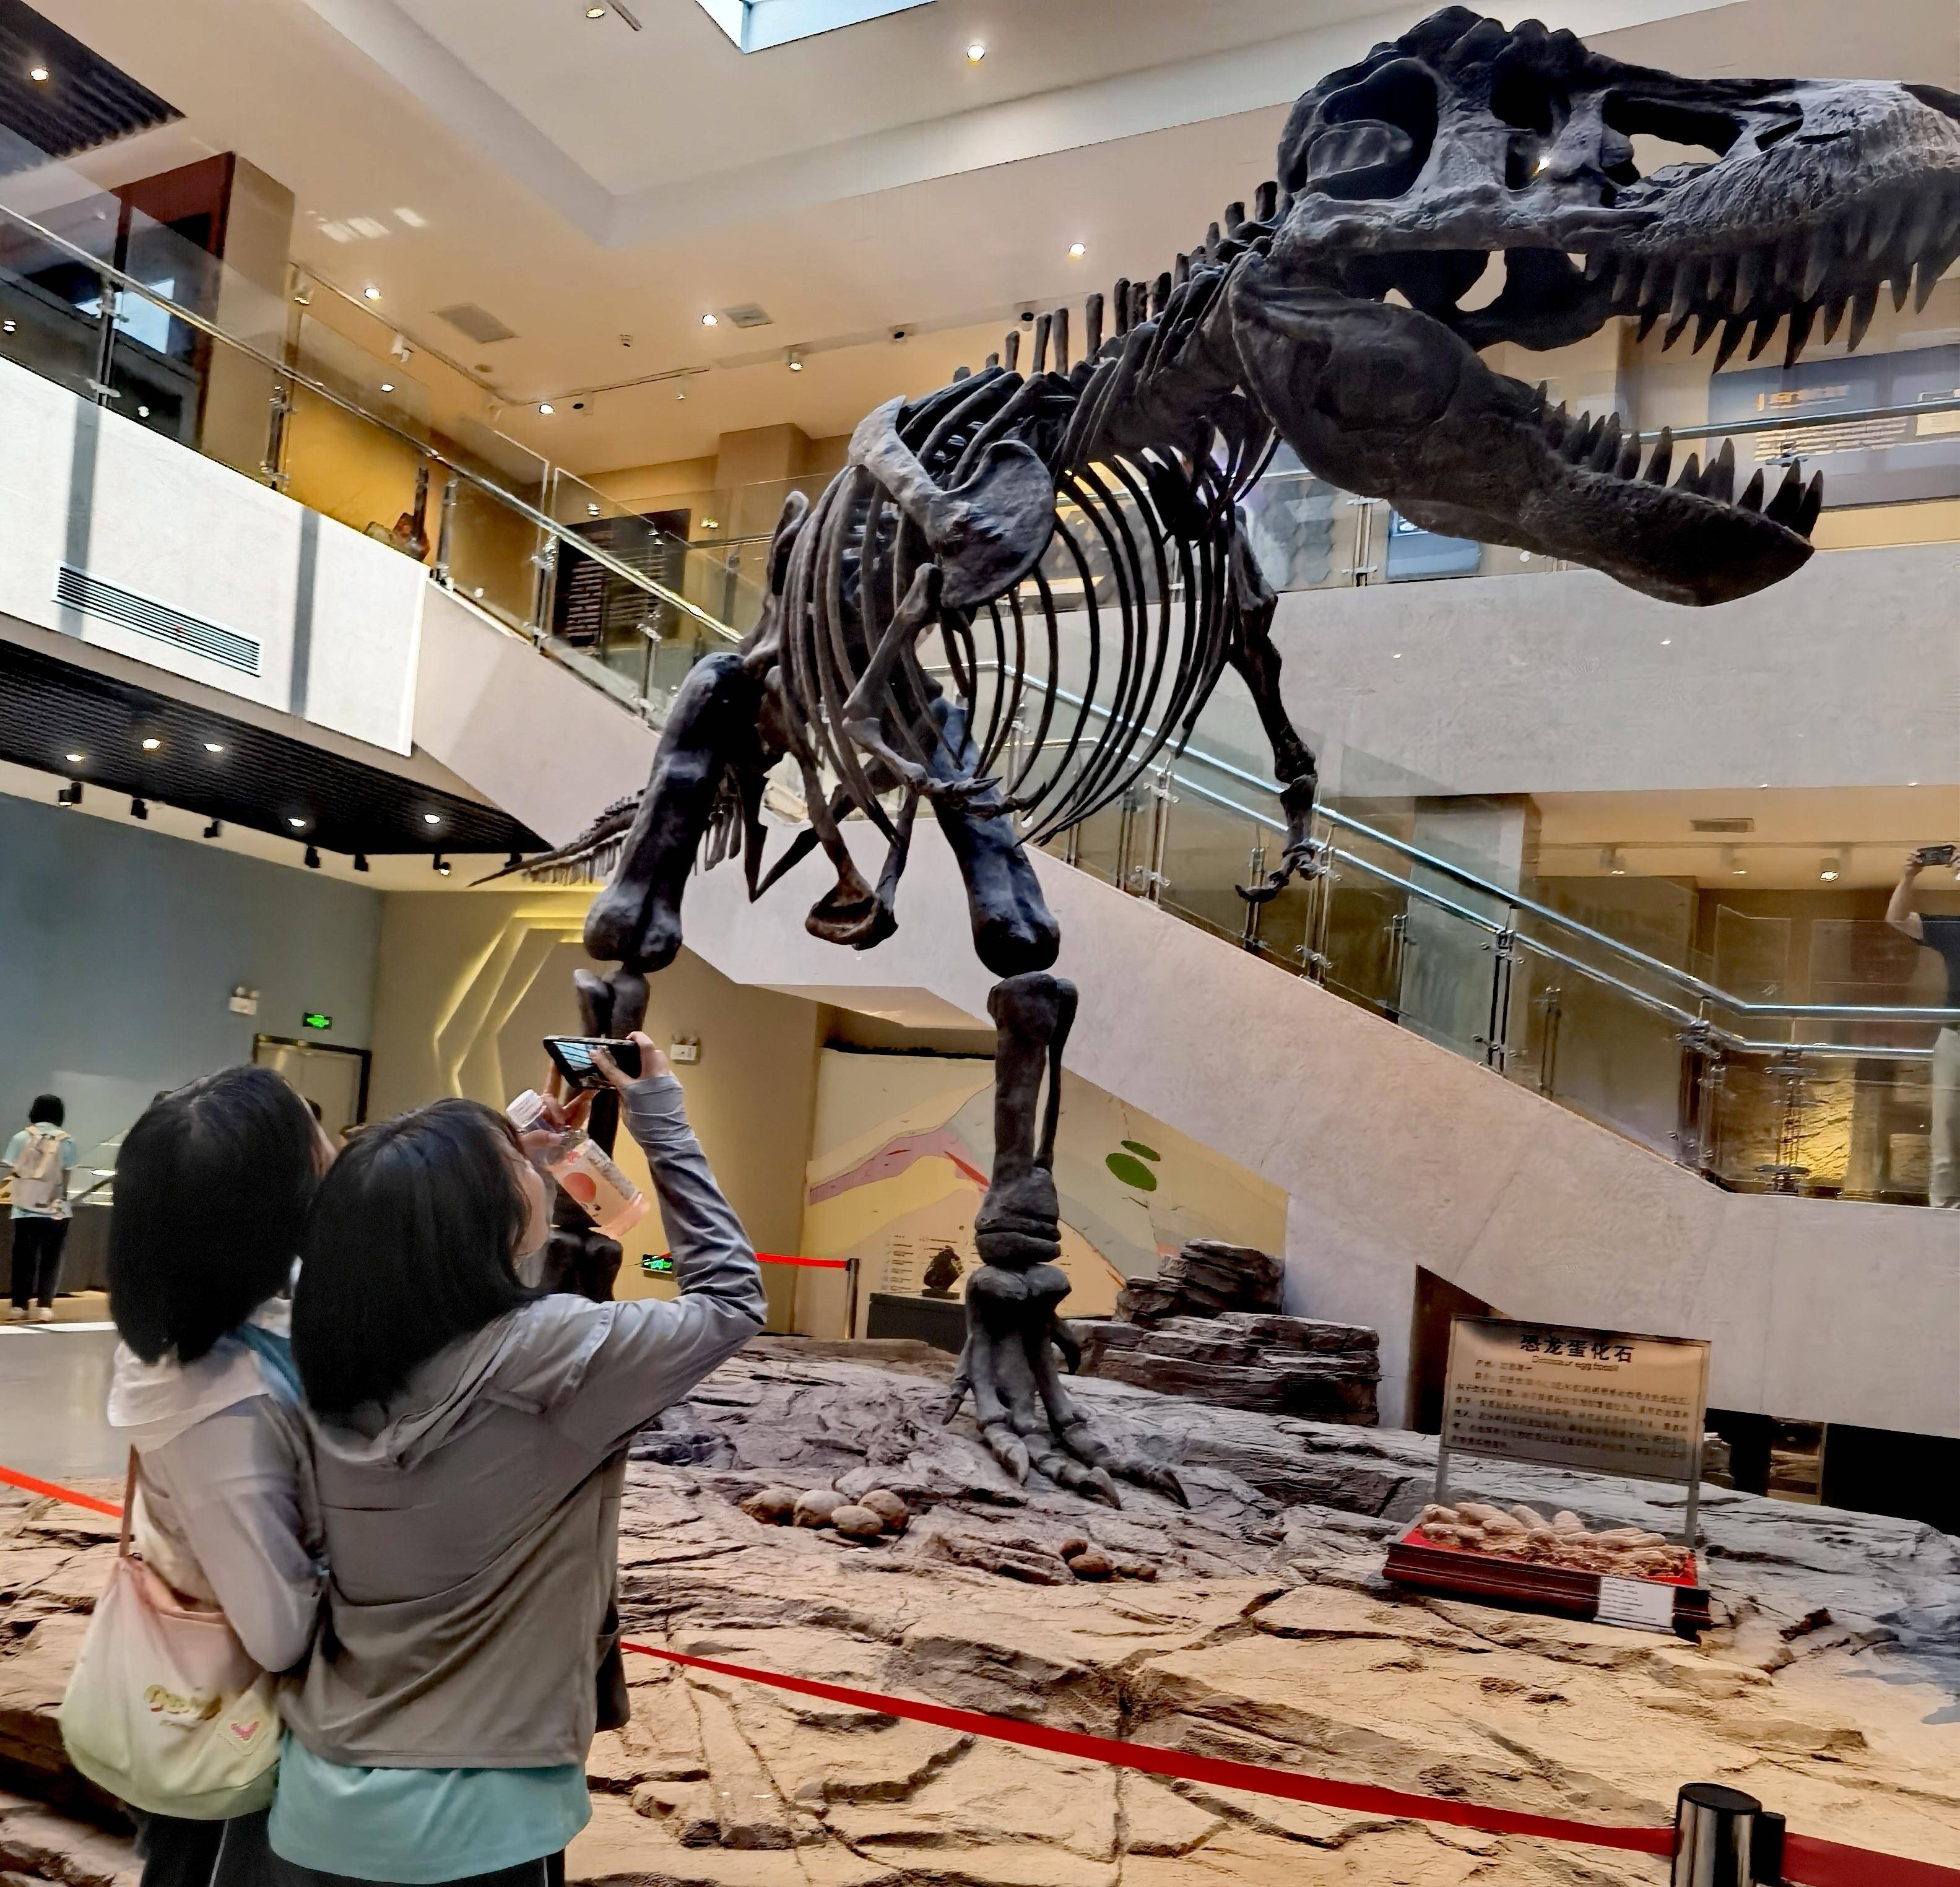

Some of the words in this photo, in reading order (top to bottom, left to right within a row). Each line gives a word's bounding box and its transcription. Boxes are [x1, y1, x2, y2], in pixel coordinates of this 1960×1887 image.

[1520, 1334, 1636, 1363] 恐龙蛋化石
